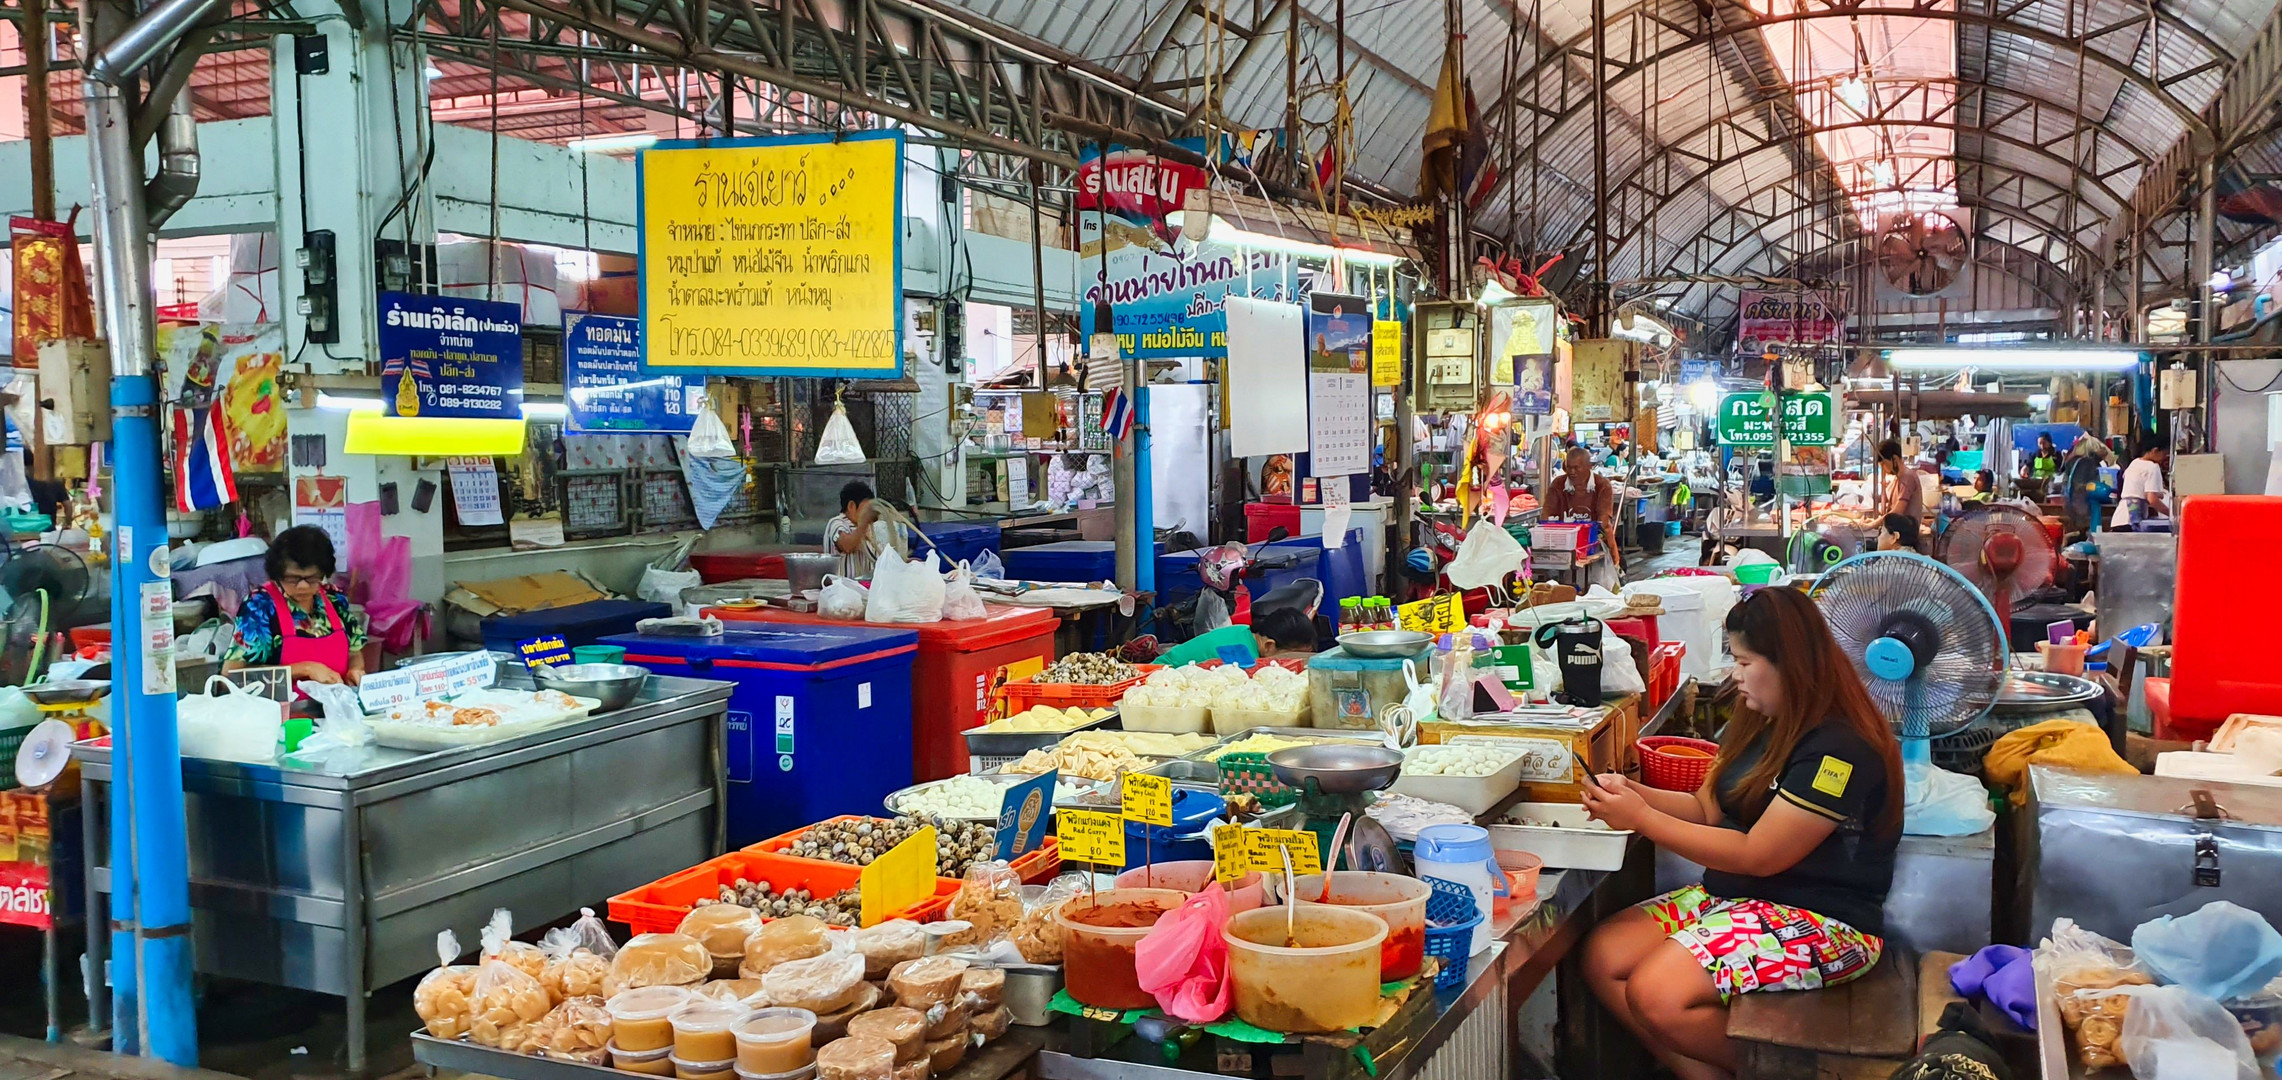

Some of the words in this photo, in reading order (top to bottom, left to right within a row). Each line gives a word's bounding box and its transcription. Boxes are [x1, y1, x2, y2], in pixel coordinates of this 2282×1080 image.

[667, 216, 715, 242] จำหน่าย
[732, 247, 794, 274] หน่อไม้จีน
[802, 247, 870, 276] น้ำพริกแกง
[786, 282, 832, 311] หนังหมู
[1142, 326, 1204, 350] หน่อไม้จีน
[439, 384, 502, 396] 081-8234767
[391, 694, 403, 704] 30
